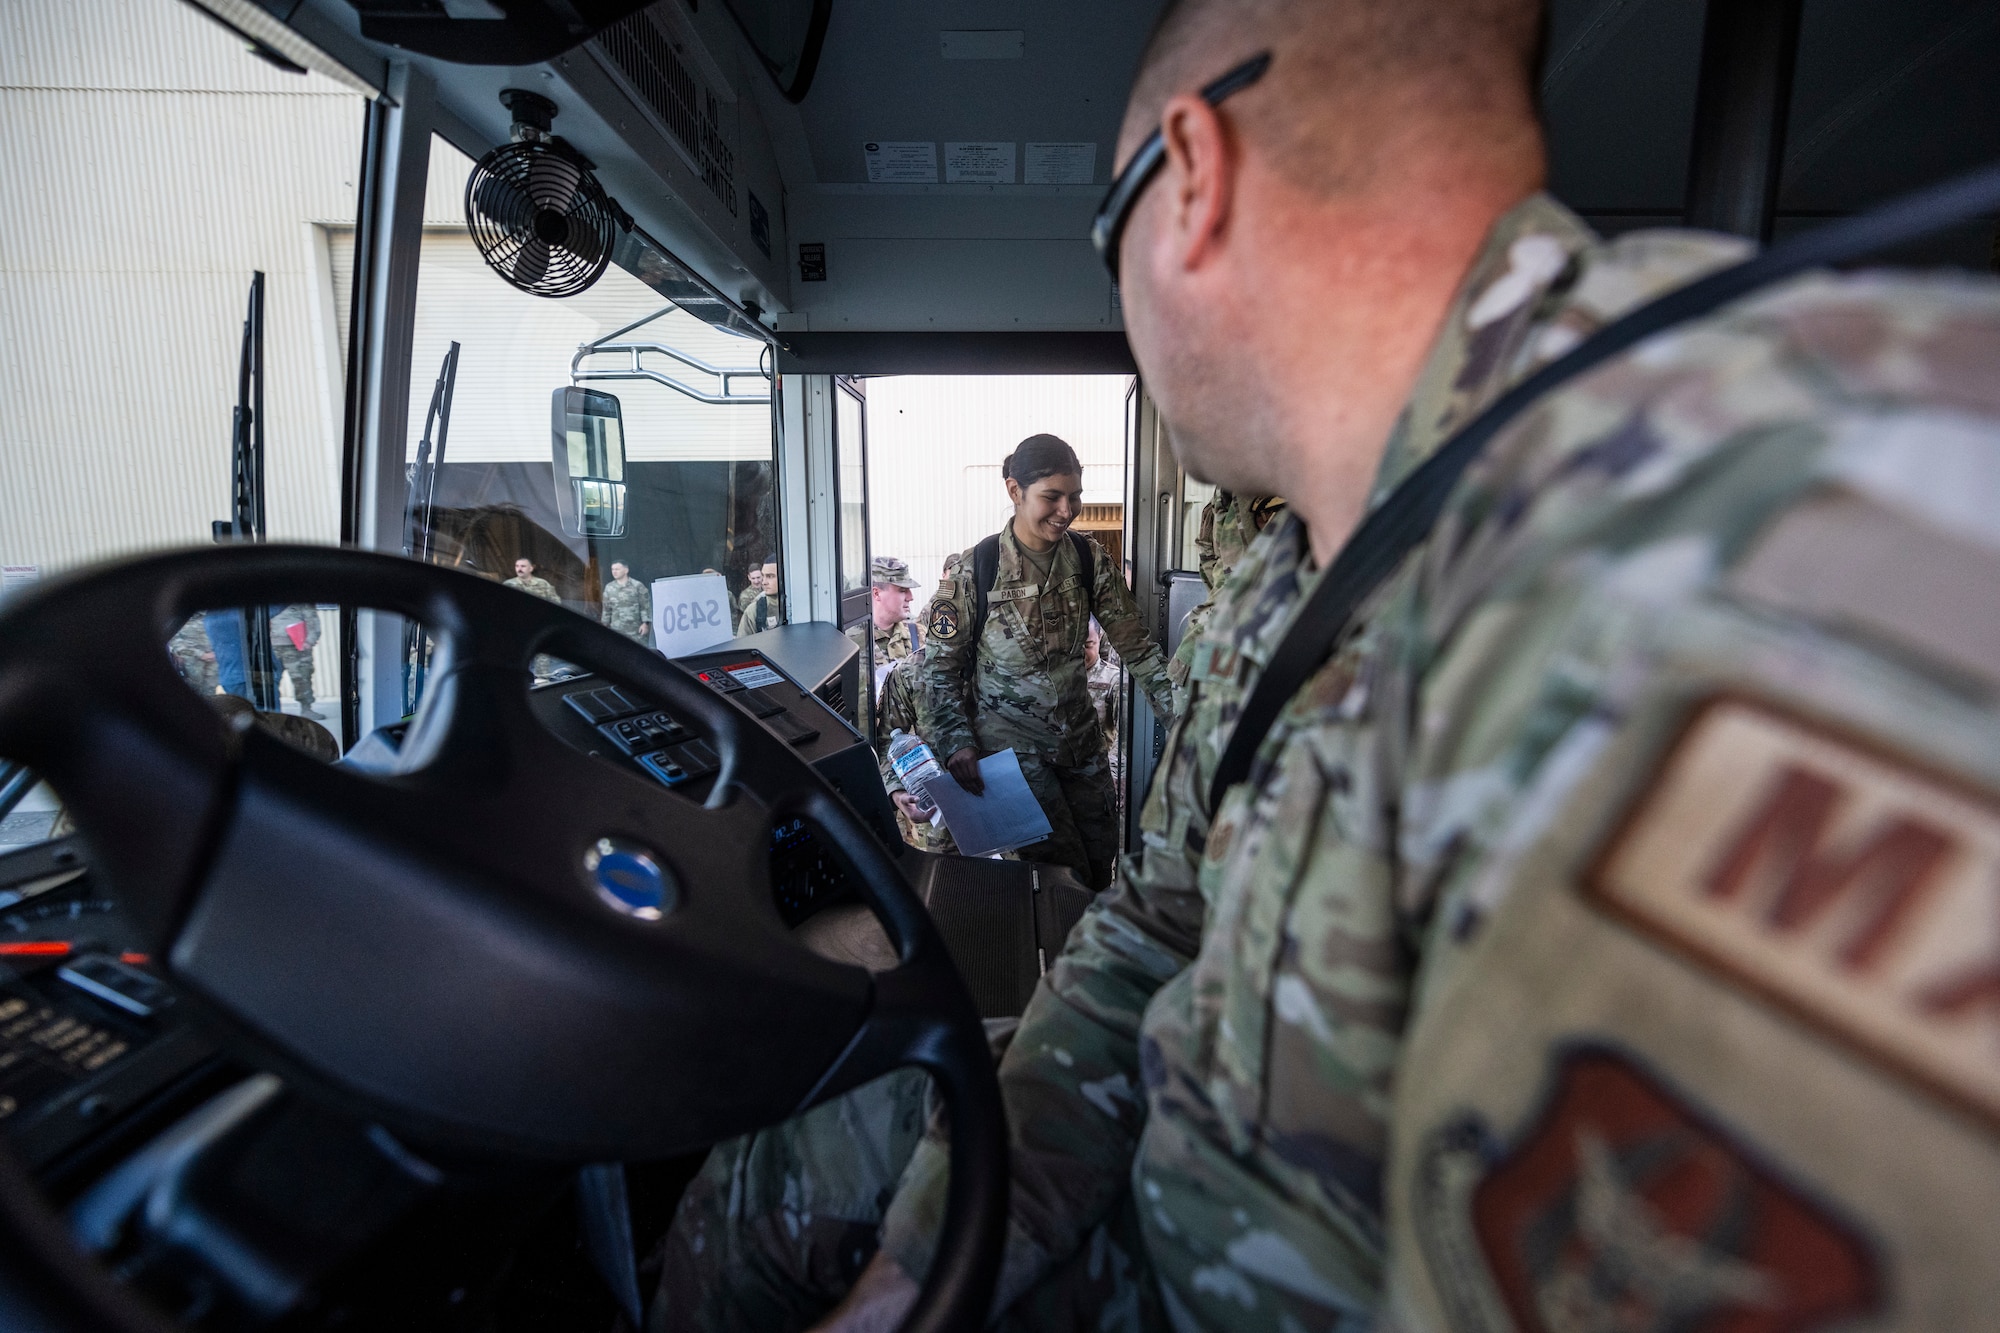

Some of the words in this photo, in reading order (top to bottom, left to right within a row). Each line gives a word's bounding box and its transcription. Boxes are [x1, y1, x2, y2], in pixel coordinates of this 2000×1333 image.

[706, 87, 718, 130] NO
[699, 110, 734, 180] TANDEES
[701, 149, 738, 218] ERMITTED
[1001, 588, 1026, 599] PABON
